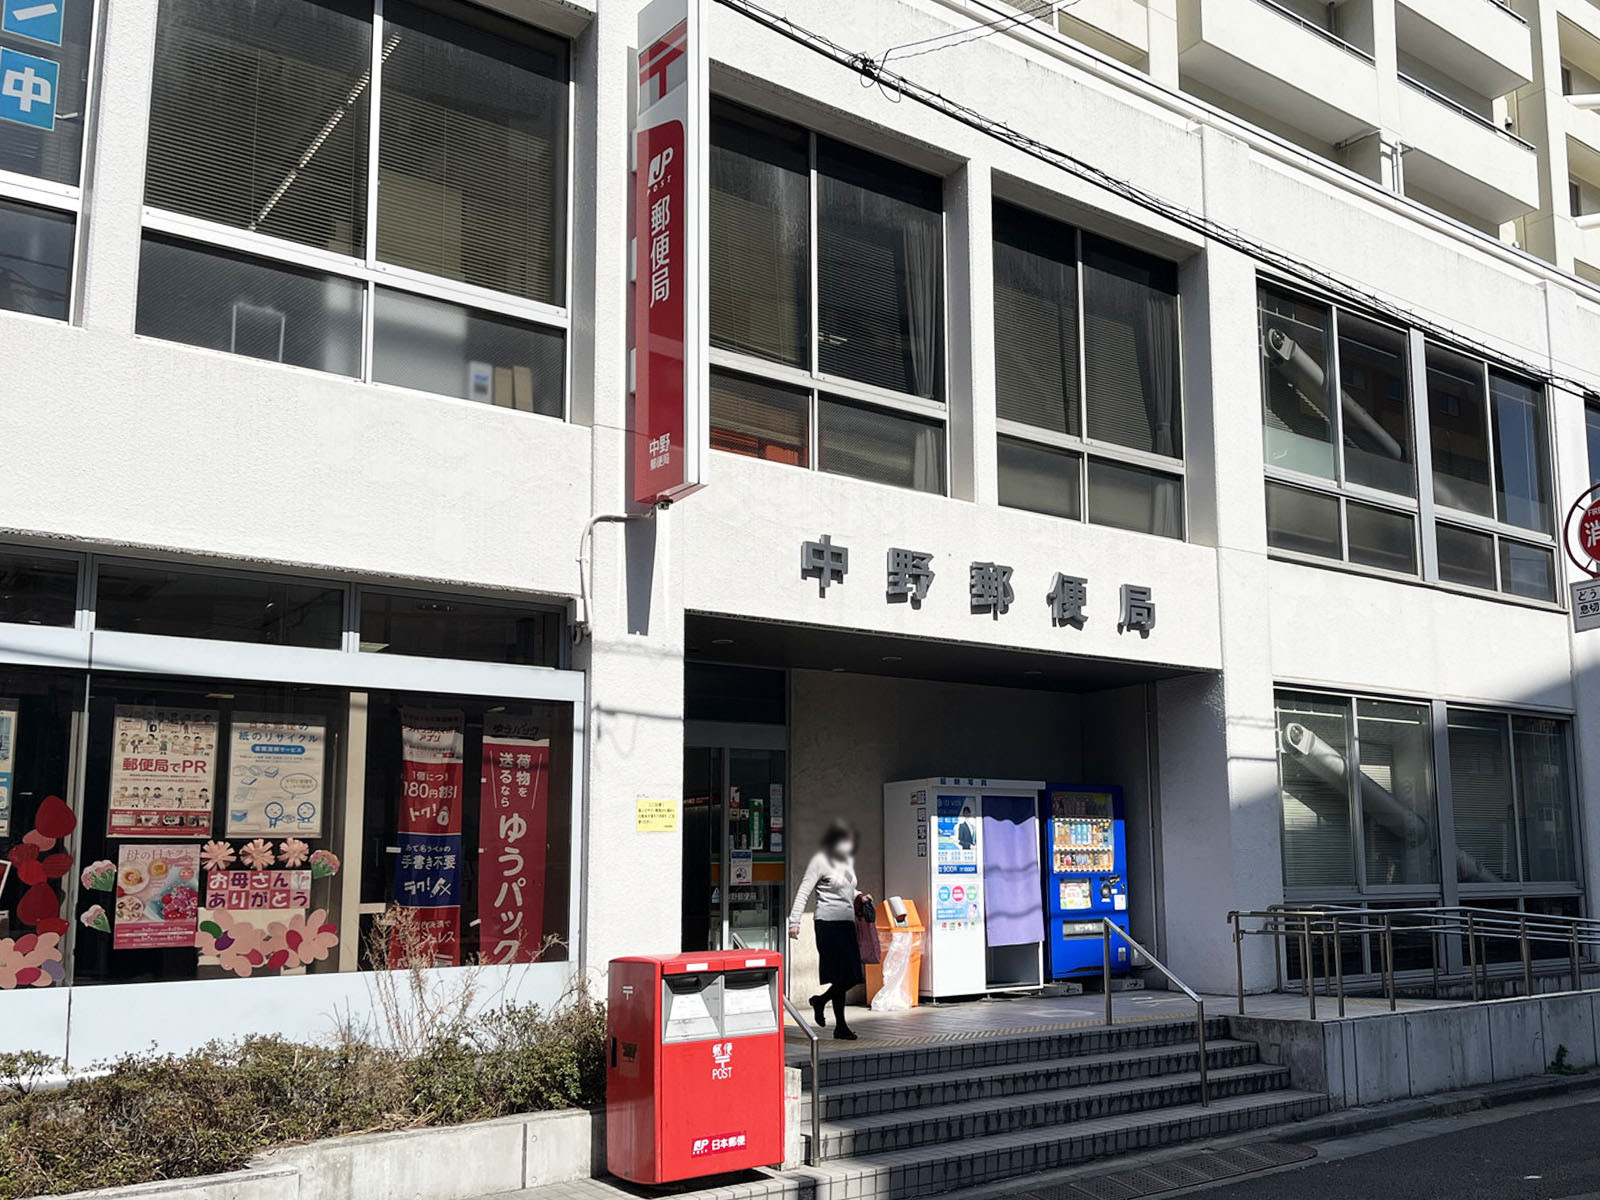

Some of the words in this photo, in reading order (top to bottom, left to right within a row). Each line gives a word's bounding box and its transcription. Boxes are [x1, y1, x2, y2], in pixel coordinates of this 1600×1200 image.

[649, 194, 671, 309] 郵便局
[649, 432, 671, 457] 中野
[800, 534, 1156, 640] 中野郵便局
[238, 731, 319, 743] 紙のリサイクル
[122, 757, 207, 774] 郵便局でPR
[499, 751, 514, 808] 送るなら
[516, 753, 532, 798] 荷物を
[401, 854, 457, 871] 手書き不要
[209, 871, 288, 890] お母さん
[494, 812, 528, 964] ゆうパック
[208, 891, 308, 909] ありがとう
[712, 1042, 733, 1057] 郵便
[712, 1066, 732, 1080] POST
[711, 1134, 746, 1151] 日本郵便
